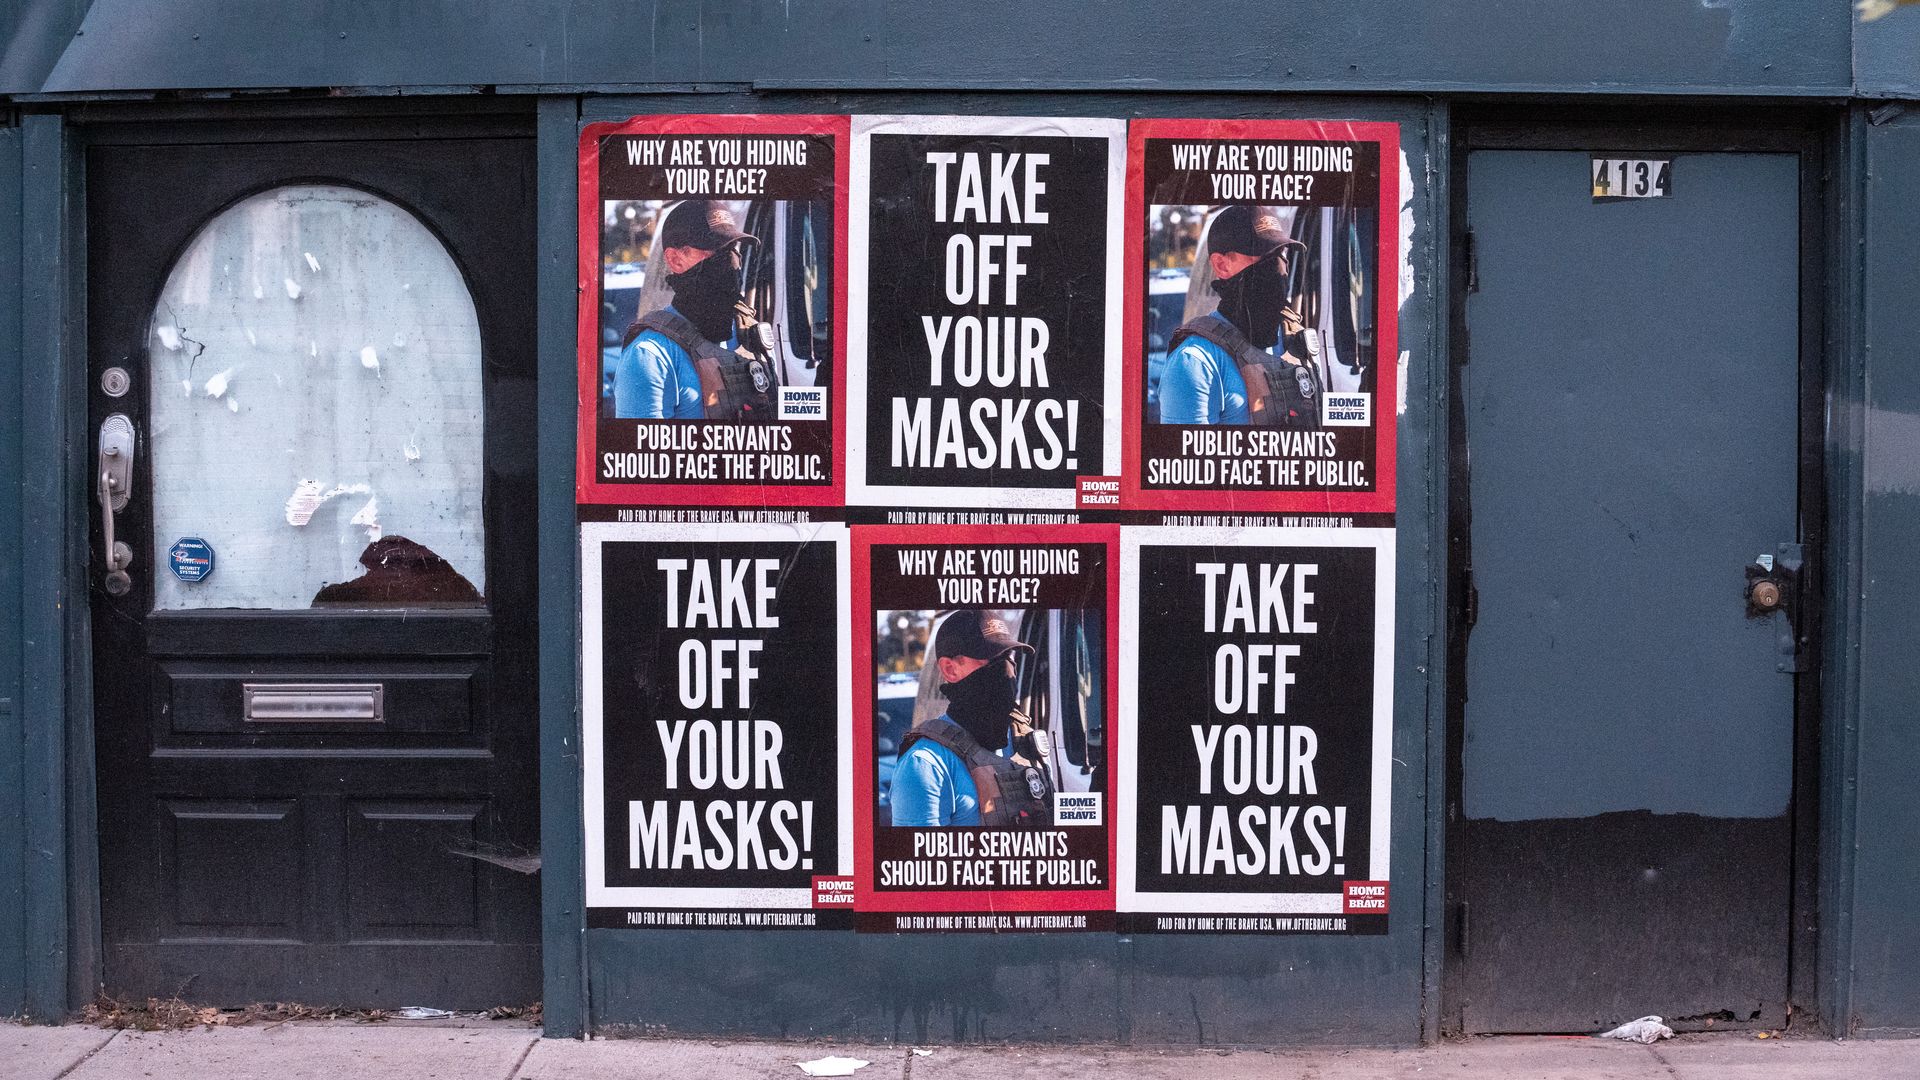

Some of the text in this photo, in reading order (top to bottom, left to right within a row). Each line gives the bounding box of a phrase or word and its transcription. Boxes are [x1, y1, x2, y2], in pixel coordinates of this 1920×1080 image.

[627, 140, 806, 165] WHY ARE YOU HIDING
[1172, 145, 1353, 172] WHY ARE YOU HIDING
[665, 168, 767, 194] YOUR FACE?
[927, 152, 1050, 224] TAKE
[1211, 174, 1313, 200] YOUR FACE?
[1595, 160, 1672, 196] 4134
[946, 234, 1032, 305] OFF
[922, 316, 1049, 388] YOUR
[784, 392, 820, 401] HOME
[1329, 398, 1364, 407] HOME
[784, 406, 820, 414] BRAVE
[1329, 412, 1364, 420] BRAVE
[638, 425, 791, 451] PUBLIC SERVANTS
[892, 397, 1079, 470] MASKS!
[1182, 430, 1336, 457] PUBLIC SERVANTS
[603, 453, 825, 480] SHOULD FACE THE PUBLIC.
[1148, 459, 1369, 486] SHOULD FACE THE PUBLIC.
[1082, 482, 1119, 490] HOME
[1082, 496, 1119, 504] BRAVE
[618, 510, 810, 523] PAID FOR BY HOME OF THE BRAVE USA. WWW.OFTHEBRAVE.ORG
[888, 512, 1080, 524] PAID FOR BY HOME OF THE BRAVE USA. WWW.OFTHEBRAVEORG
[1163, 516, 1353, 528] PAID FOR BY HOME OF THE BRAVE USA WWWOFTHEBRAVEORG
[898, 549, 1079, 575] WHY ARE YOU HIDING
[657, 559, 780, 629] TAKE
[937, 578, 1040, 603] YOUR FACE?
[1195, 563, 1318, 634] TAKE
[679, 639, 763, 710] OFF
[1215, 644, 1300, 715] OFF
[656, 720, 784, 790] YOUR
[1191, 725, 1317, 796] YOUR
[1060, 798, 1096, 806] HOME
[1060, 811, 1096, 819] BRAVE
[628, 800, 813, 871] MASKS!
[914, 832, 1068, 857] PUBLIC SERVANTS
[1161, 805, 1346, 876] MASKS!
[881, 860, 1101, 885] SHOULD FACE THE PUBLIC.
[818, 881, 854, 890] HOME
[1349, 886, 1385, 895] HOME
[818, 895, 854, 903] BRAVE
[1349, 900, 1385, 908] BRAVE
[628, 912, 816, 925] PAID FOR BY HOME OF THE BRAVE USA. WWW.OFTHEBRAVE.ORG
[897, 916, 1086, 928] PAID FOR BY HOME OF THE BRAVE USA. WWW.OFTHEBRAVE.ORG
[1158, 918, 1347, 930] PAID FOR BY HOME OF THE BRAVE USA. WWW.OFTHEBRAVE.ORG
